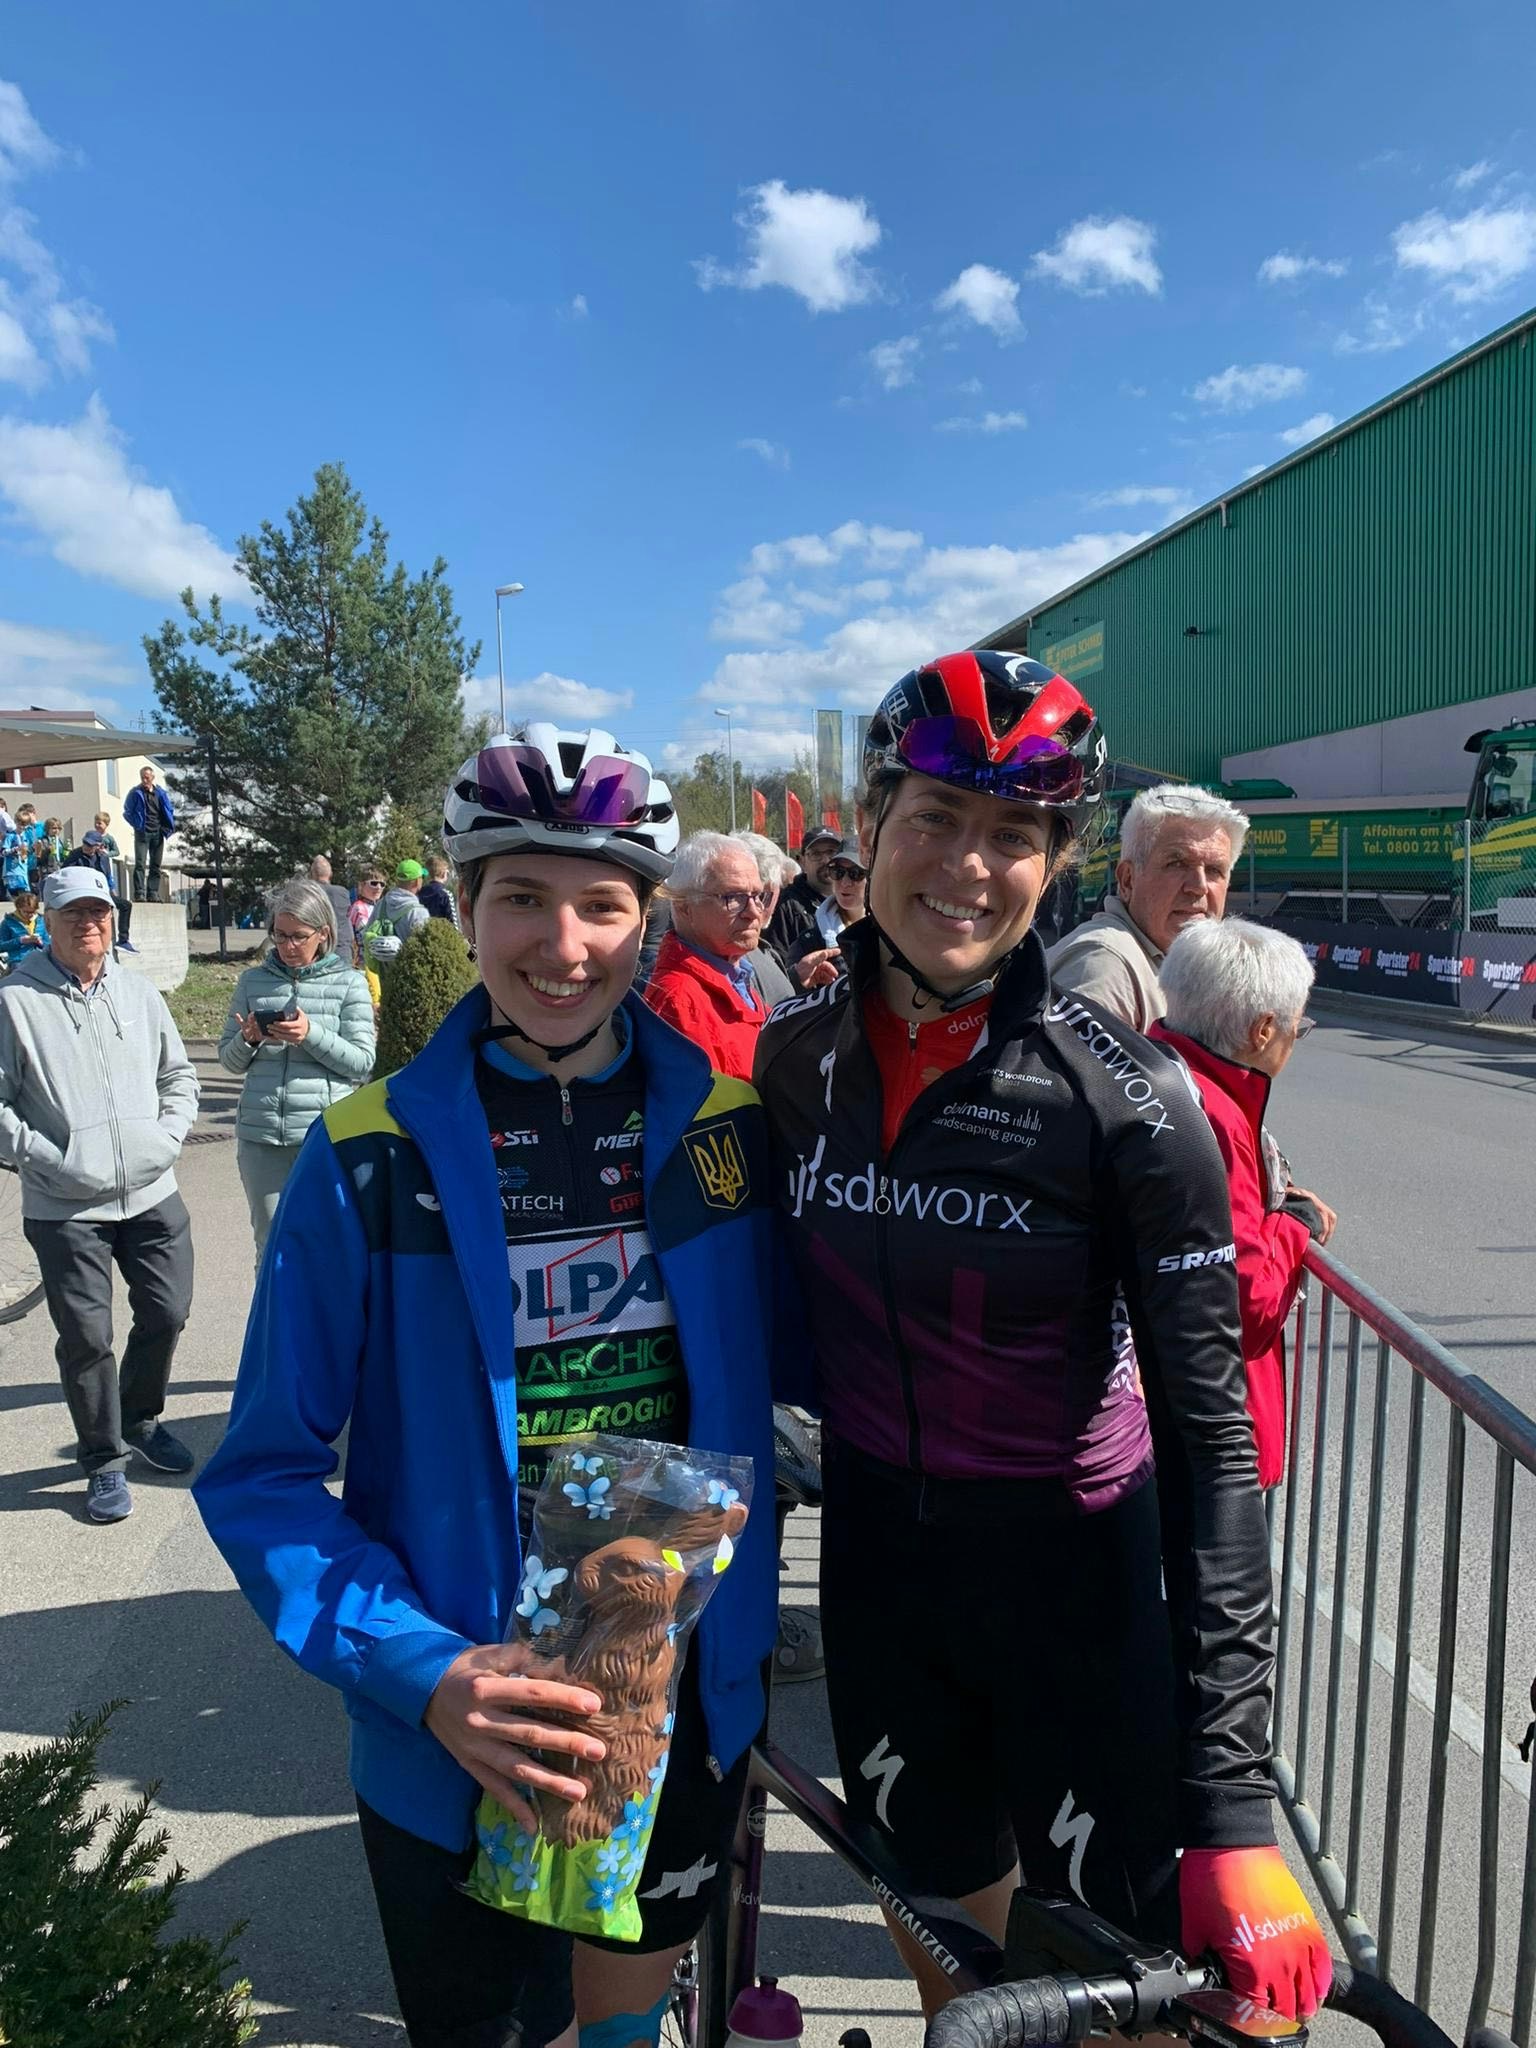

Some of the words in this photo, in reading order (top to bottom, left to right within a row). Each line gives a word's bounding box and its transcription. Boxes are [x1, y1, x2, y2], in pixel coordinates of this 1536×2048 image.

[1363, 825, 1416, 837] Affoltern
[1420, 827, 1439, 836] am
[1363, 842, 1383, 853] Tel.
[1387, 841, 1419, 853] 0800
[1423, 841, 1440, 853] 22
[1004, 1070, 1054, 1087] WORLDTOUR
[1077, 1020, 1176, 1140] sdworx
[943, 1101, 1011, 1124] dolmans
[1001, 1129, 1037, 1150] group
[824, 1162, 1034, 1234] sdworx
[1157, 1243, 1237, 1274] SRAM
[511, 1253, 664, 1325] LPA
[516, 1335, 675, 1382] ARCHIO
[871, 1875, 960, 1976] SPECIALIZED
[1254, 1911, 1309, 1941] sdworx
